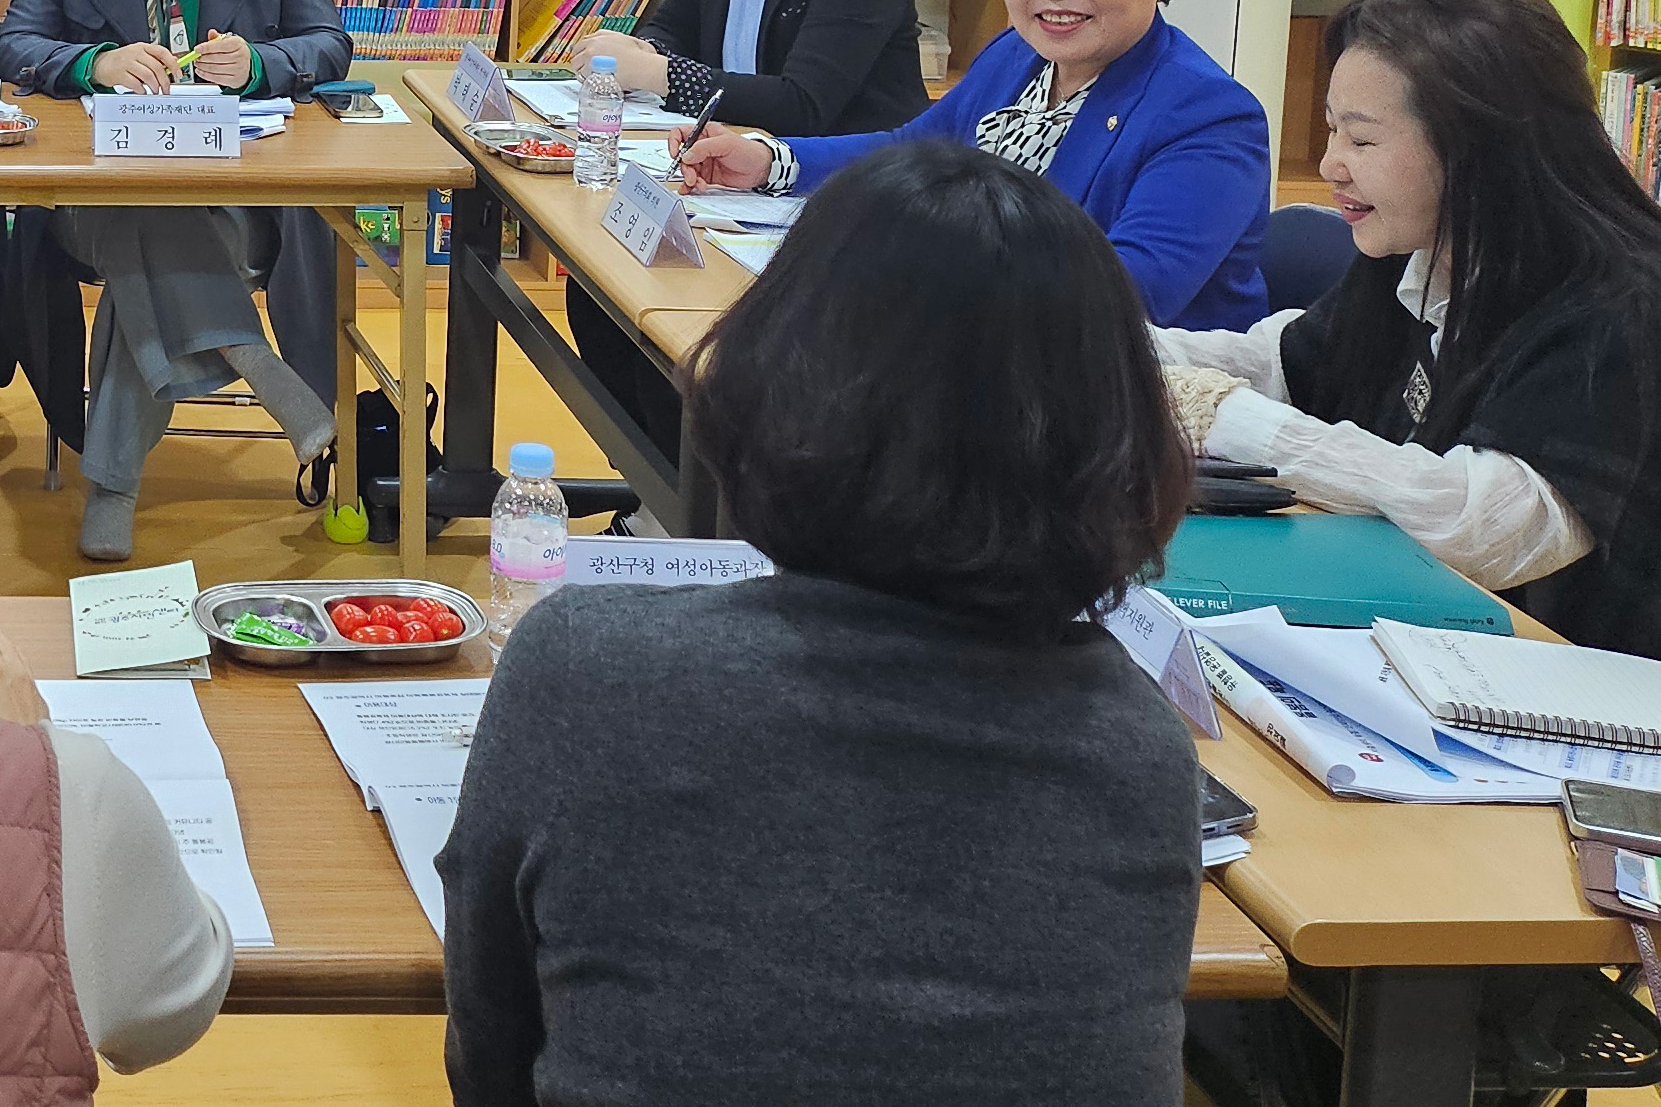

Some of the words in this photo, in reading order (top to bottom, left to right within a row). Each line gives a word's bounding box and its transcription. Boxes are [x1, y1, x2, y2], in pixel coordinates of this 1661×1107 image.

[197, 105, 216, 115] 대표
[589, 556, 656, 576] 광산구청
[1174, 597, 1205, 609] LEVER
[1207, 599, 1228, 610] FILE
